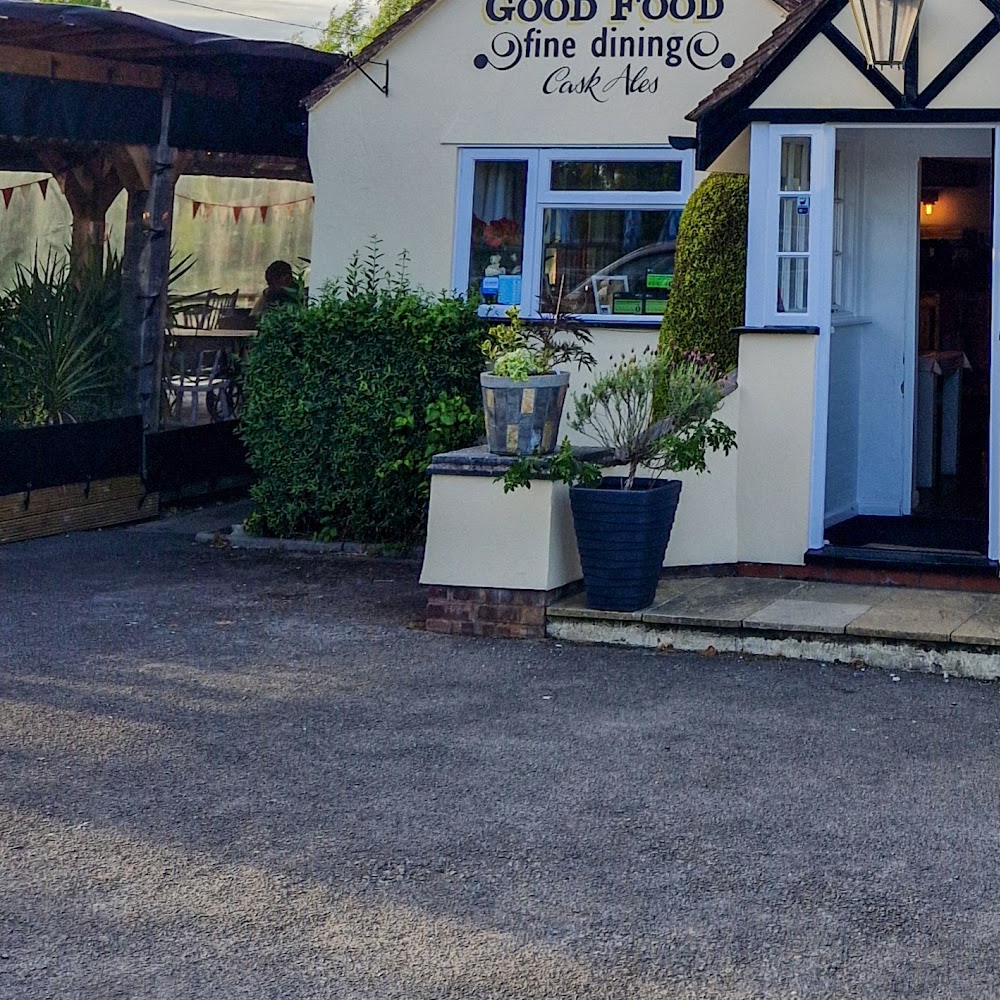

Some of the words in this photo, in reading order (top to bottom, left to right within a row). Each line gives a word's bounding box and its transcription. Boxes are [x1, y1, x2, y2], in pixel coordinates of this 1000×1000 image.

[523, 27, 577, 58] fine
[591, 27, 684, 67] dining
[542, 65, 610, 103] Cask
[602, 63, 659, 96] Ales
